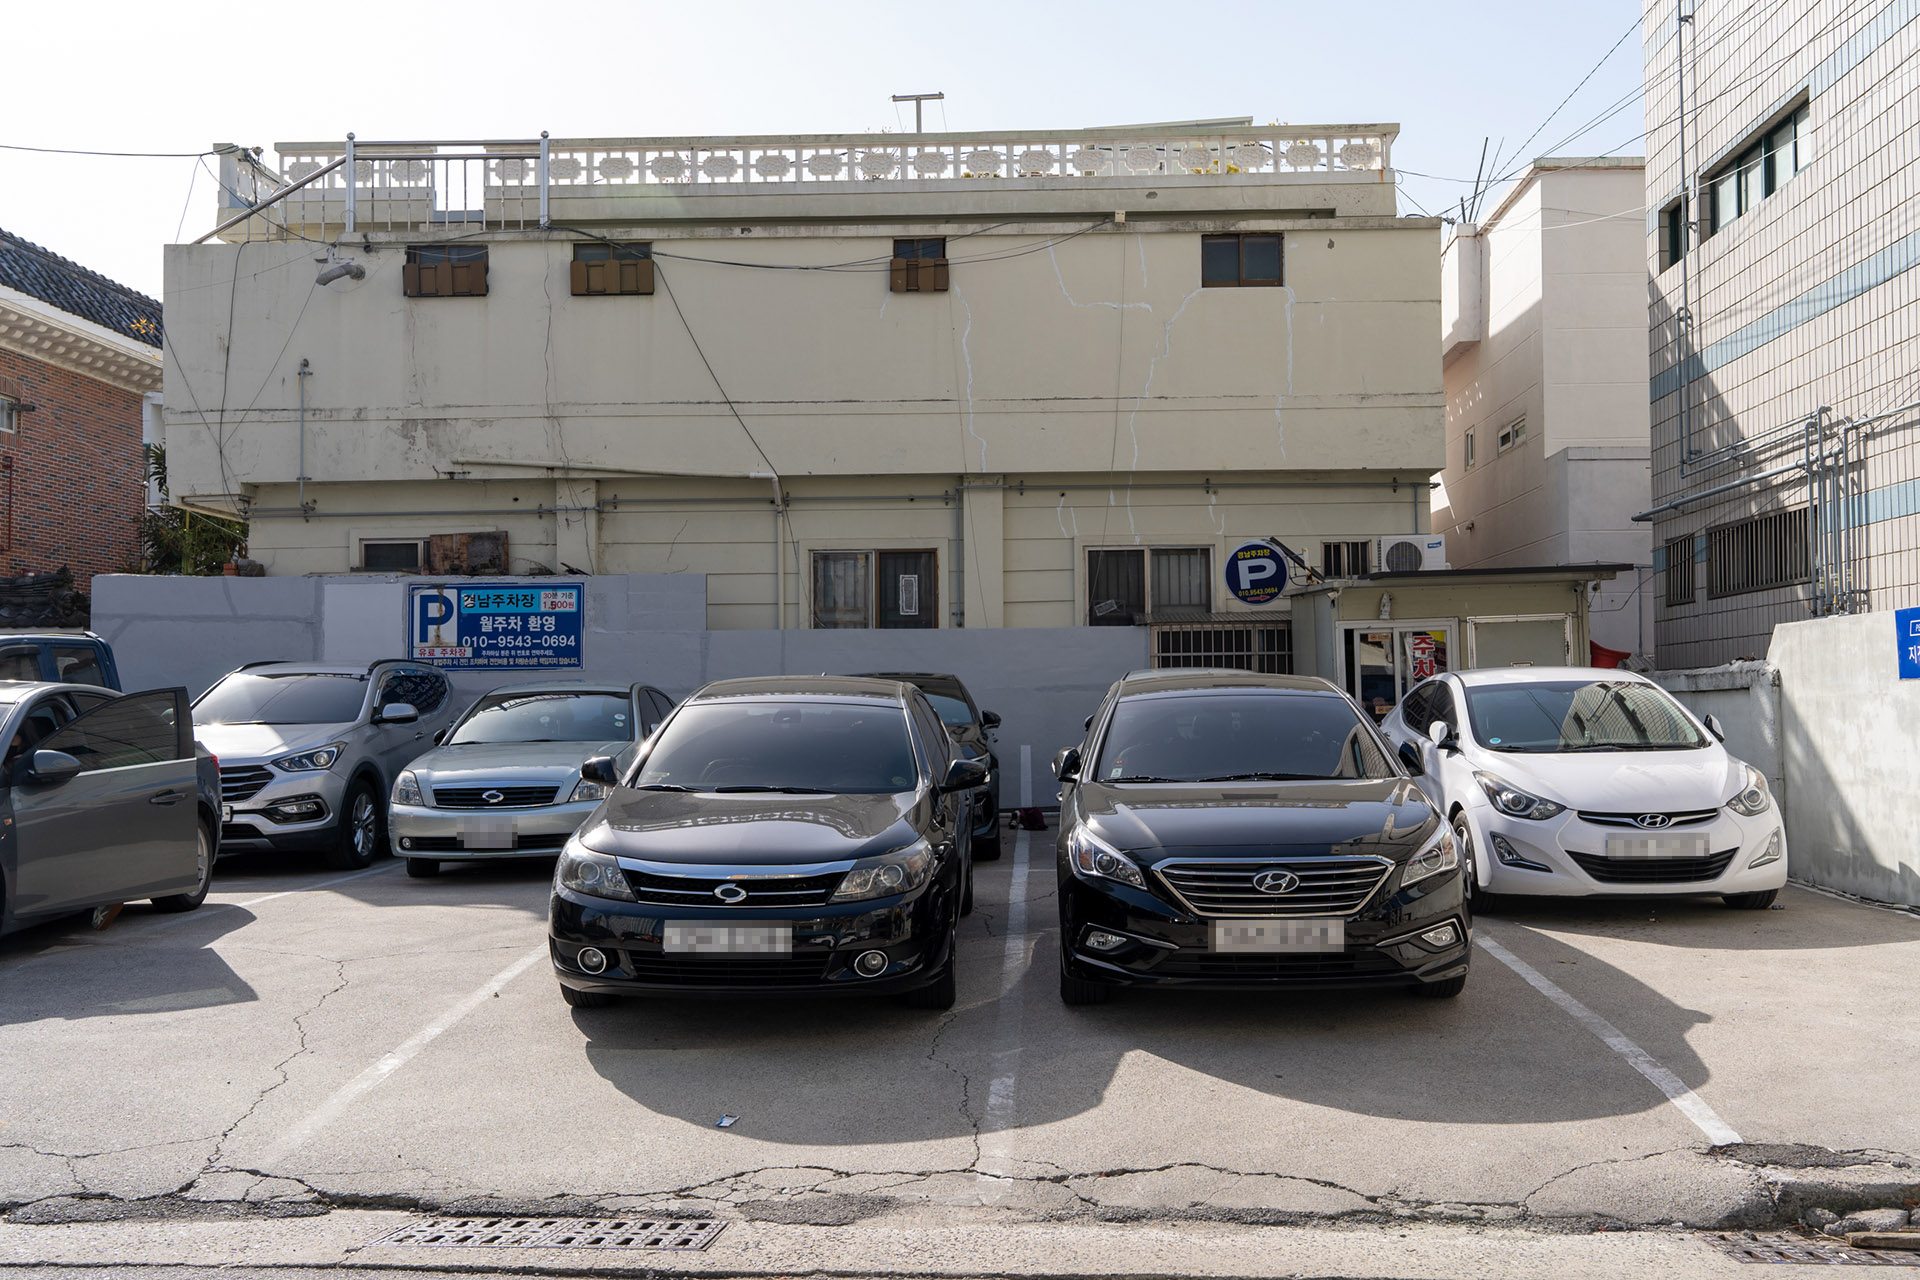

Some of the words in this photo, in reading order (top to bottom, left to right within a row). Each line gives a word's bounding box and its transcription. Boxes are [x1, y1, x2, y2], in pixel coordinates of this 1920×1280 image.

[1237, 549, 1270, 559] 경남주차장
[1237, 558, 1277, 590] P
[463, 593, 535, 609] 경남주차장
[419, 594, 454, 643] P
[479, 615, 522, 632] 월주차
[527, 615, 556, 632] 환영
[462, 635, 576, 647] 010-9543-0694
[418, 649, 436, 657] 유료
[440, 648, 466, 657] 주차장
